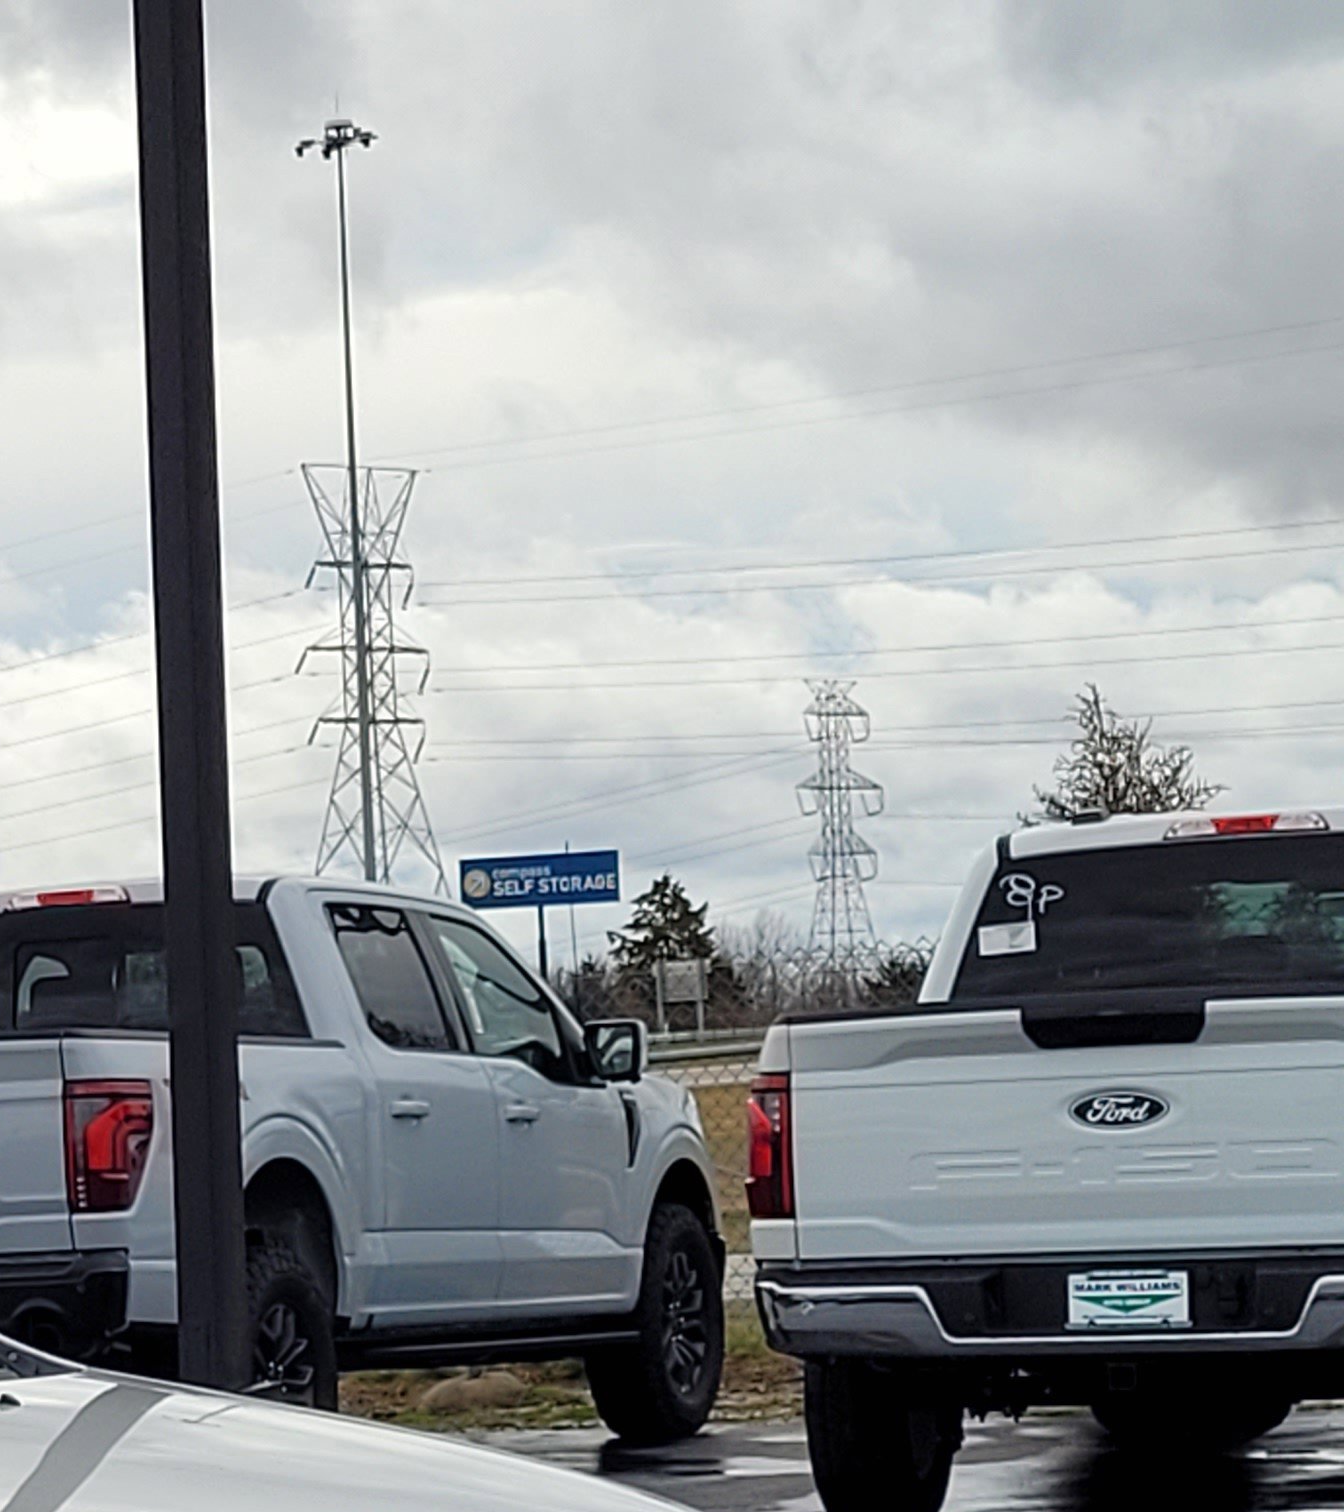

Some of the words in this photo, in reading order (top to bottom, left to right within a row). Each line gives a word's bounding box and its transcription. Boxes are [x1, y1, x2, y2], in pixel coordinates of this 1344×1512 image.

[492, 879, 535, 897] SELF
[537, 872, 616, 894] STORAGE
[1085, 1096, 1150, 1123] Ford
[1074, 1283, 1111, 1292] MARK
[1116, 1281, 1180, 1292] WILLIAMS
